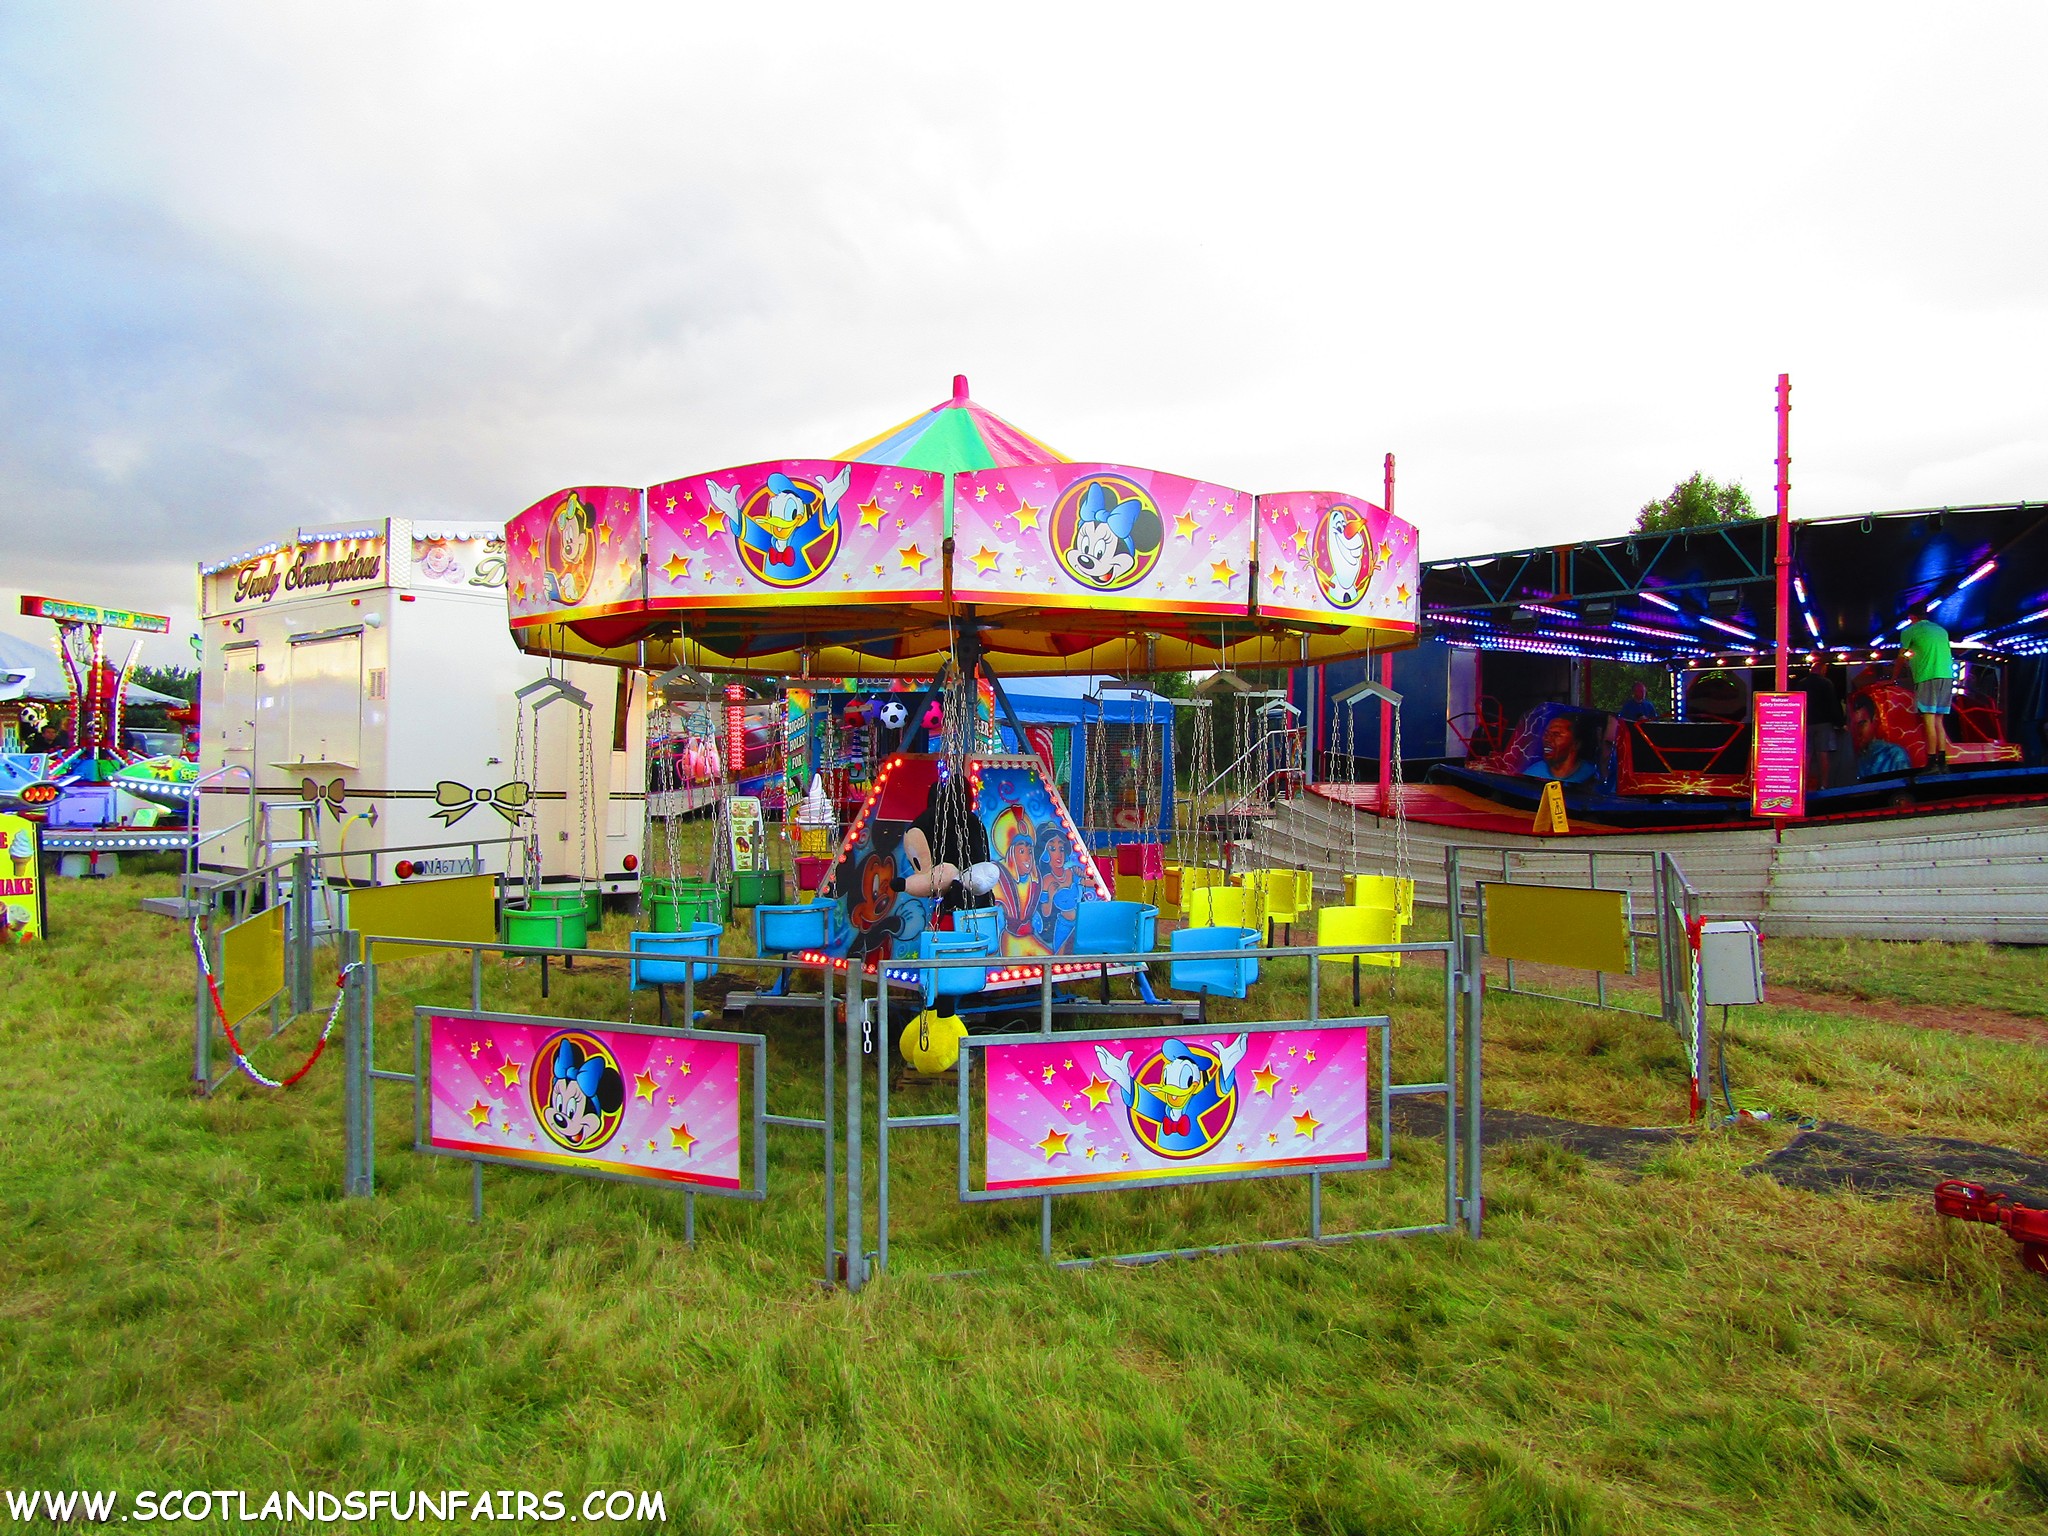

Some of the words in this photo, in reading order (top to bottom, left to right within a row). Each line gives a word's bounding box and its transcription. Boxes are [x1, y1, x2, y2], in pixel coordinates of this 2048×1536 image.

[234, 562, 281, 602] Truly
[285, 549, 381, 591] Scrumptious
[41, 600, 98, 624] SUPER
[103, 610, 129, 627] JET
[133, 614, 167, 630] RIDE
[30, 756, 41, 772] 2
